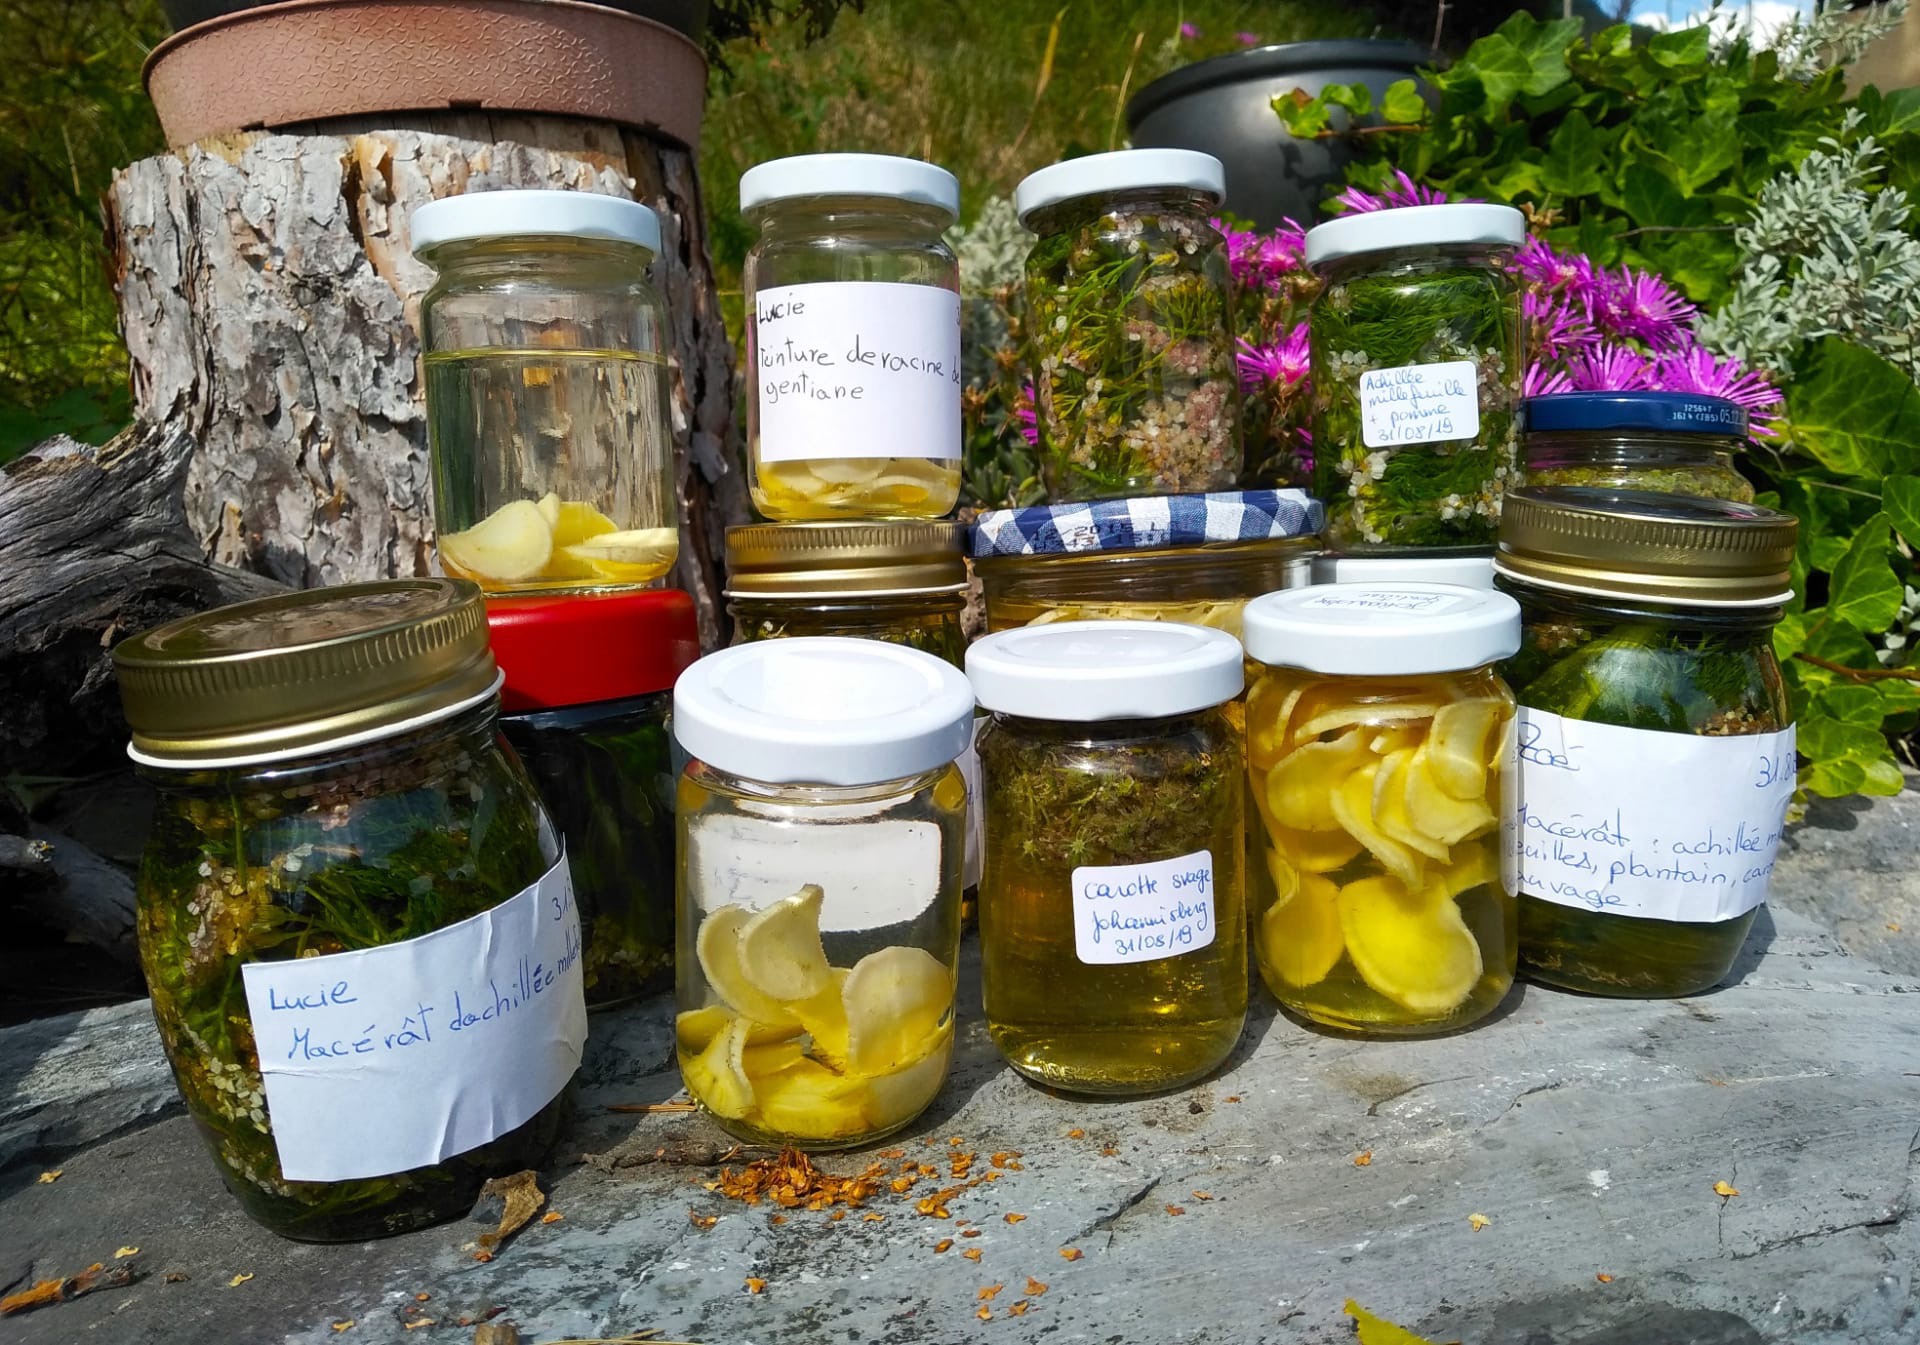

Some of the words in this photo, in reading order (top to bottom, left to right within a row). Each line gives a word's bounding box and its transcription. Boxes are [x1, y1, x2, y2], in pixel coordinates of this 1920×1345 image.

[759, 292, 805, 325] Lucie
[766, 370, 865, 404] gentiane
[1518, 722, 1584, 771] Zoé
[1517, 839, 1598, 875] euilles,
[1517, 870, 1641, 909] auvage.
[1115, 924, 1193, 956] 31/08/19
[269, 981, 358, 1011] Lucie
[287, 1002, 434, 1061] Macérât
